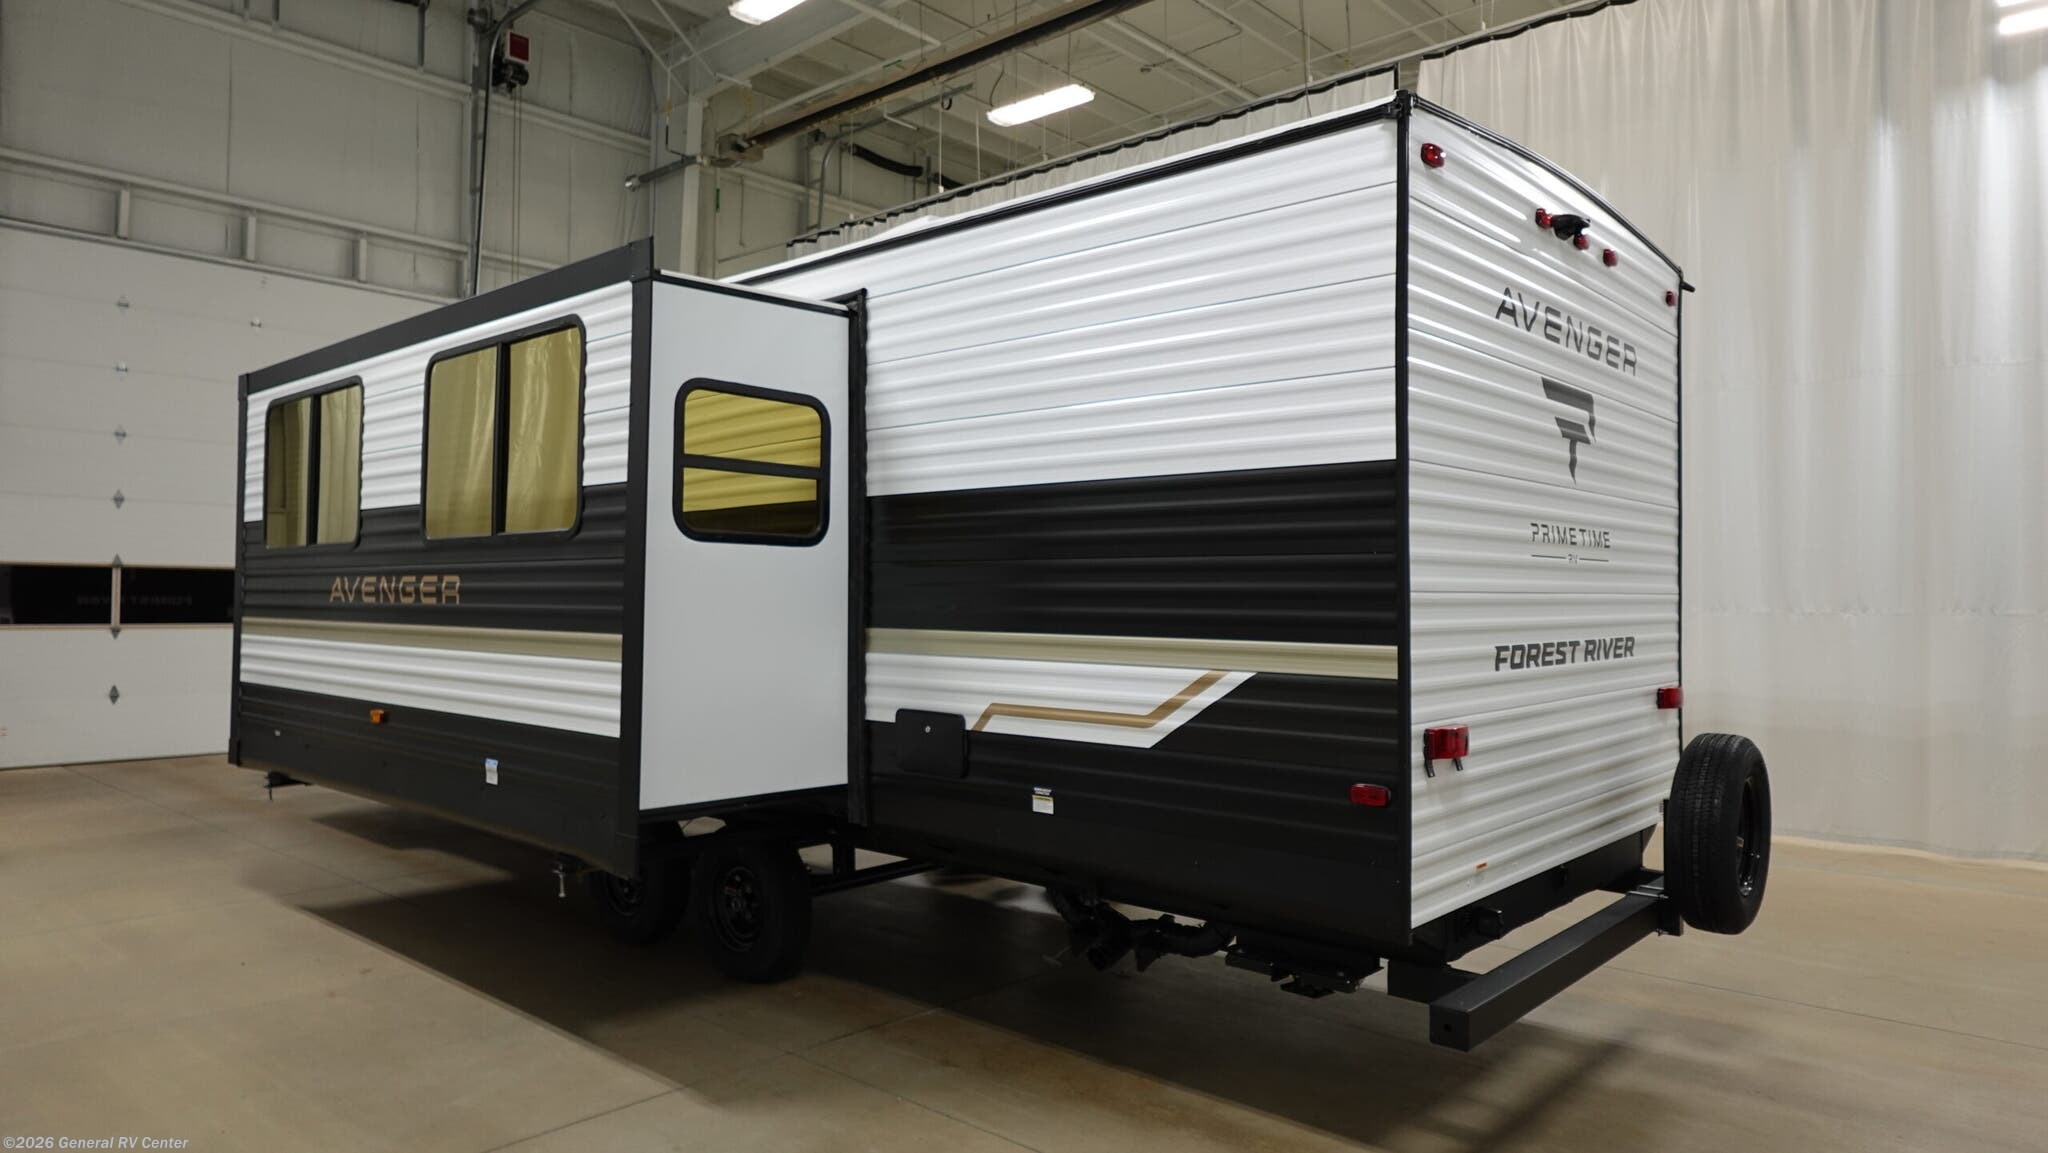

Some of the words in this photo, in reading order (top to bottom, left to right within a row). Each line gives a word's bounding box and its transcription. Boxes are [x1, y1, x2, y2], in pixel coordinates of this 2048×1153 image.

[1495, 287, 1637, 376] AVENGER
[329, 575, 460, 605] AVENGER
[1494, 640, 1581, 672] FOREST
[1584, 636, 1635, 662] RIVER
